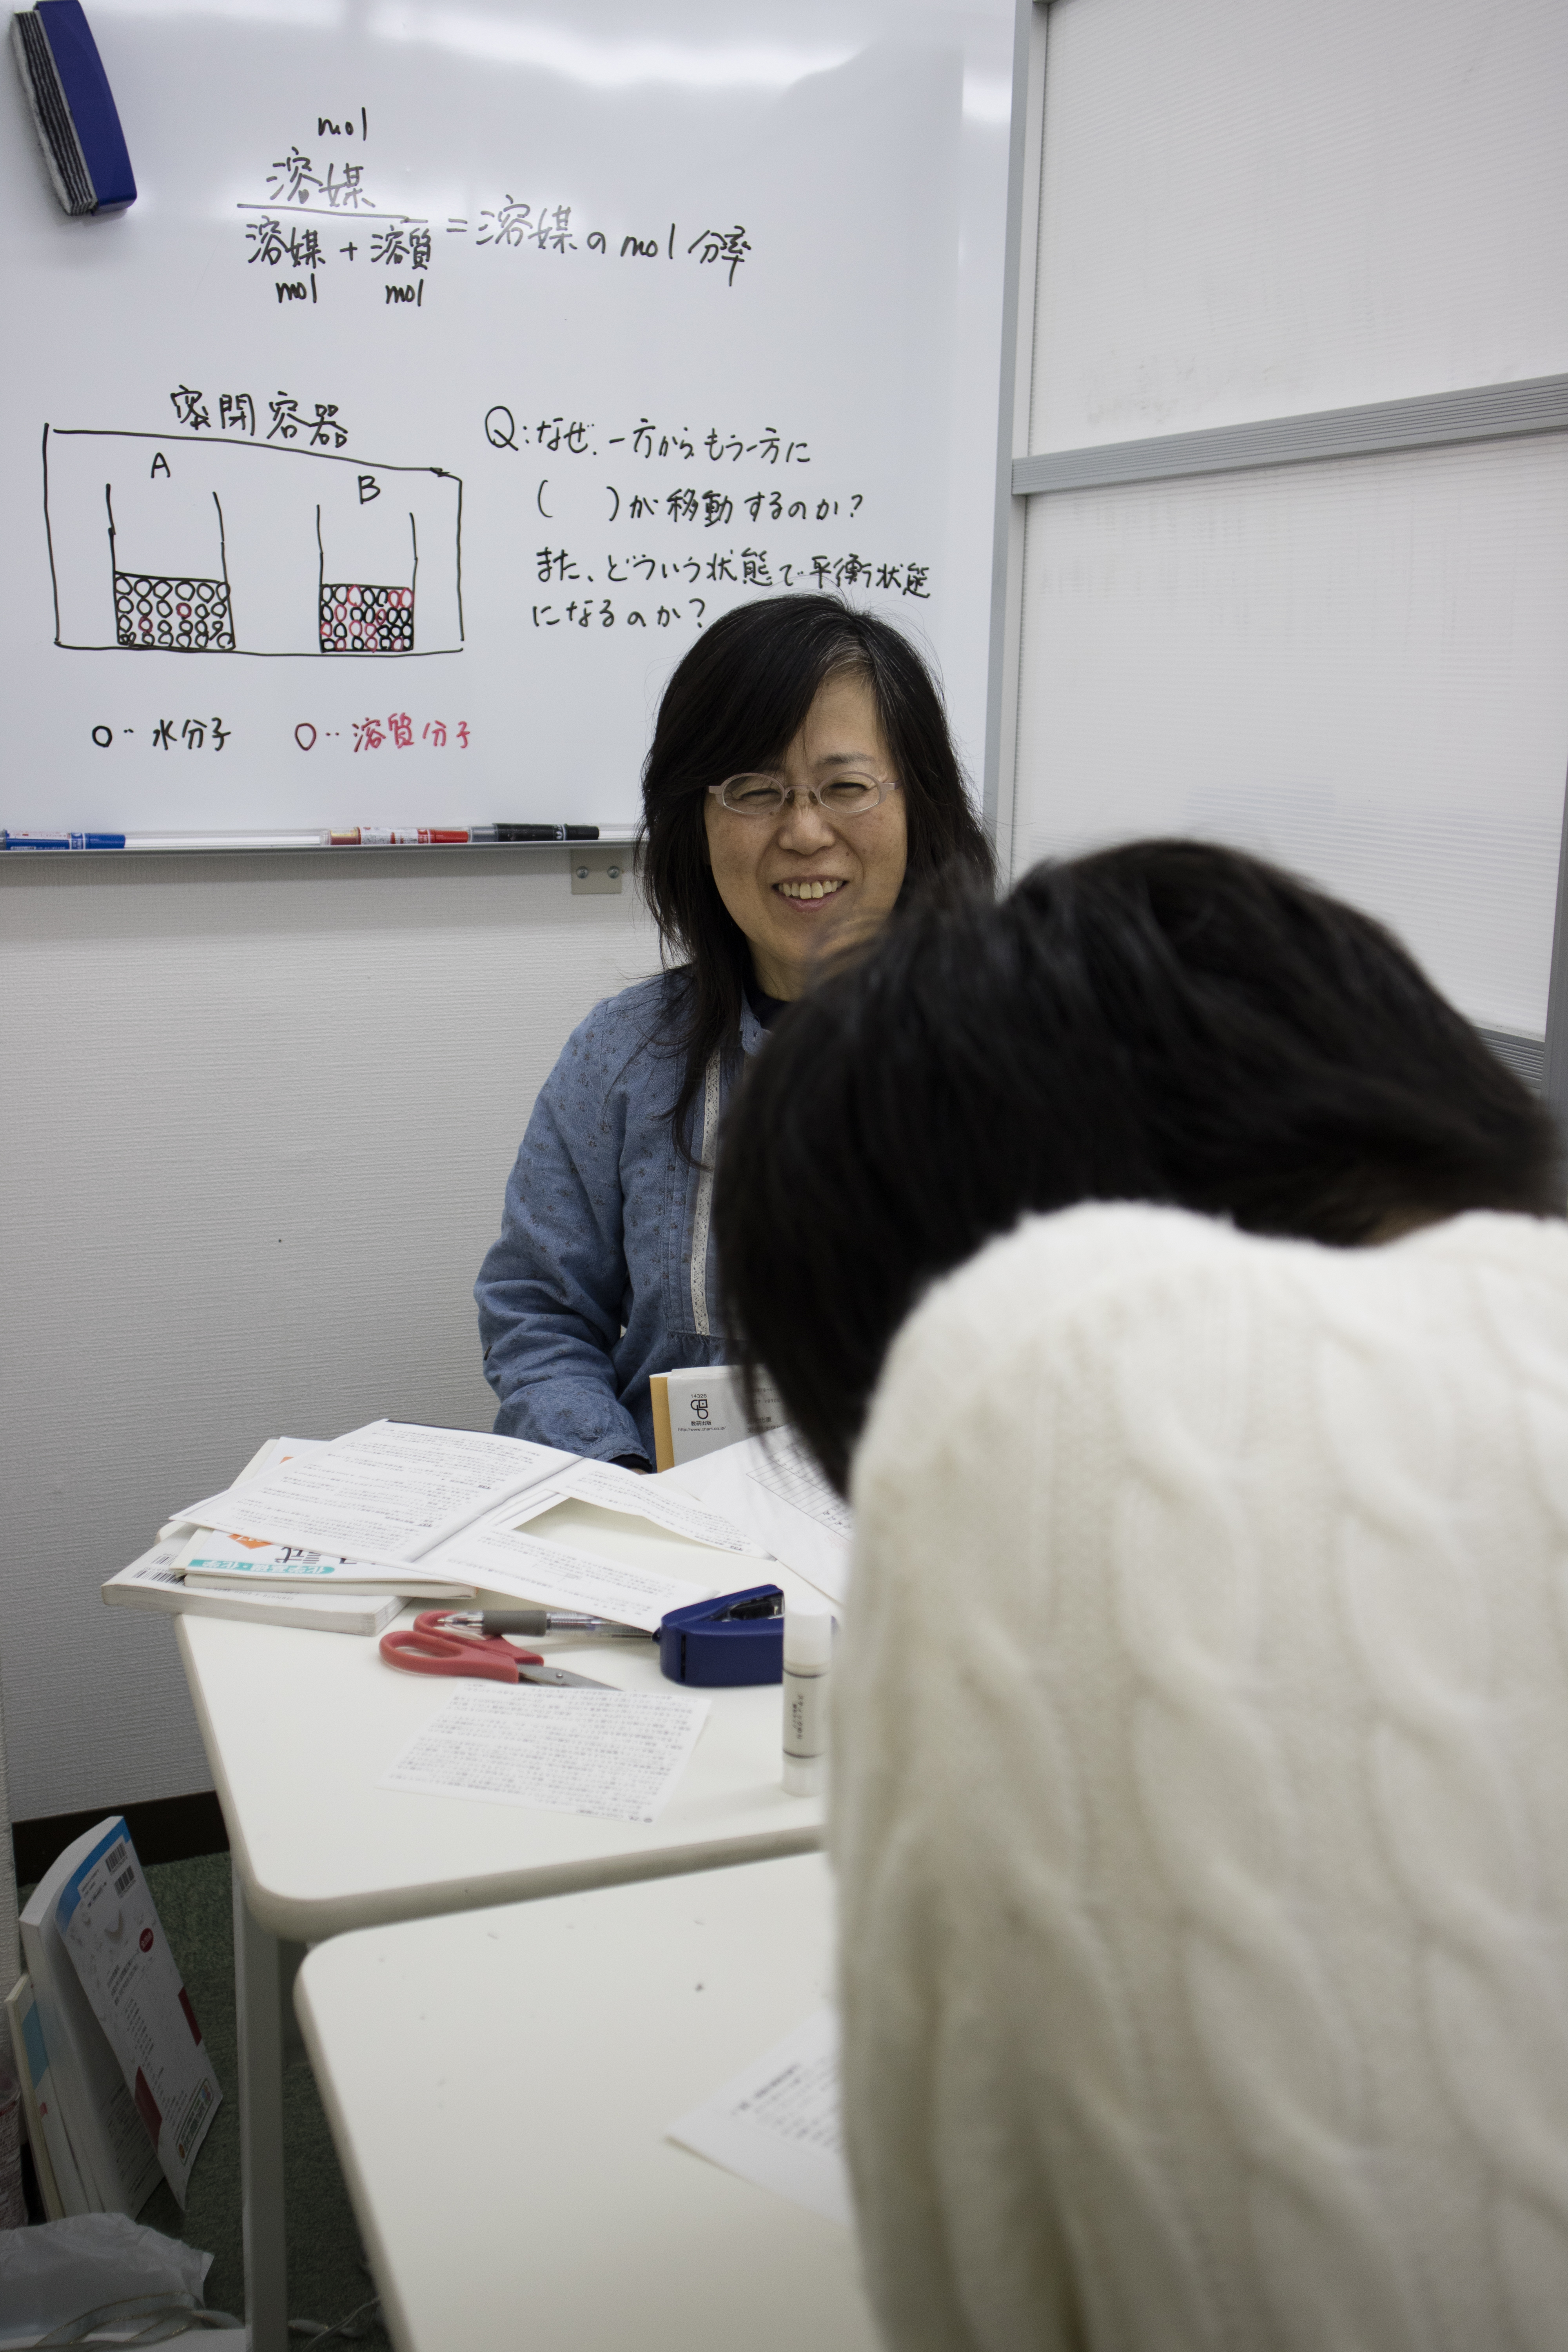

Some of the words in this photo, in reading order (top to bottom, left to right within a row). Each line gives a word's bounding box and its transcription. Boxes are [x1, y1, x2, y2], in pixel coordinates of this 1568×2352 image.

[318, 107, 367, 141] mol
[266, 146, 375, 207] 溶媒
[245, 216, 326, 267] 溶媒
[370, 226, 432, 270] 溶質
[275, 273, 318, 304] mol
[385, 279, 424, 307] mol
[151, 452, 171, 479] A
[358, 475, 381, 505] B
